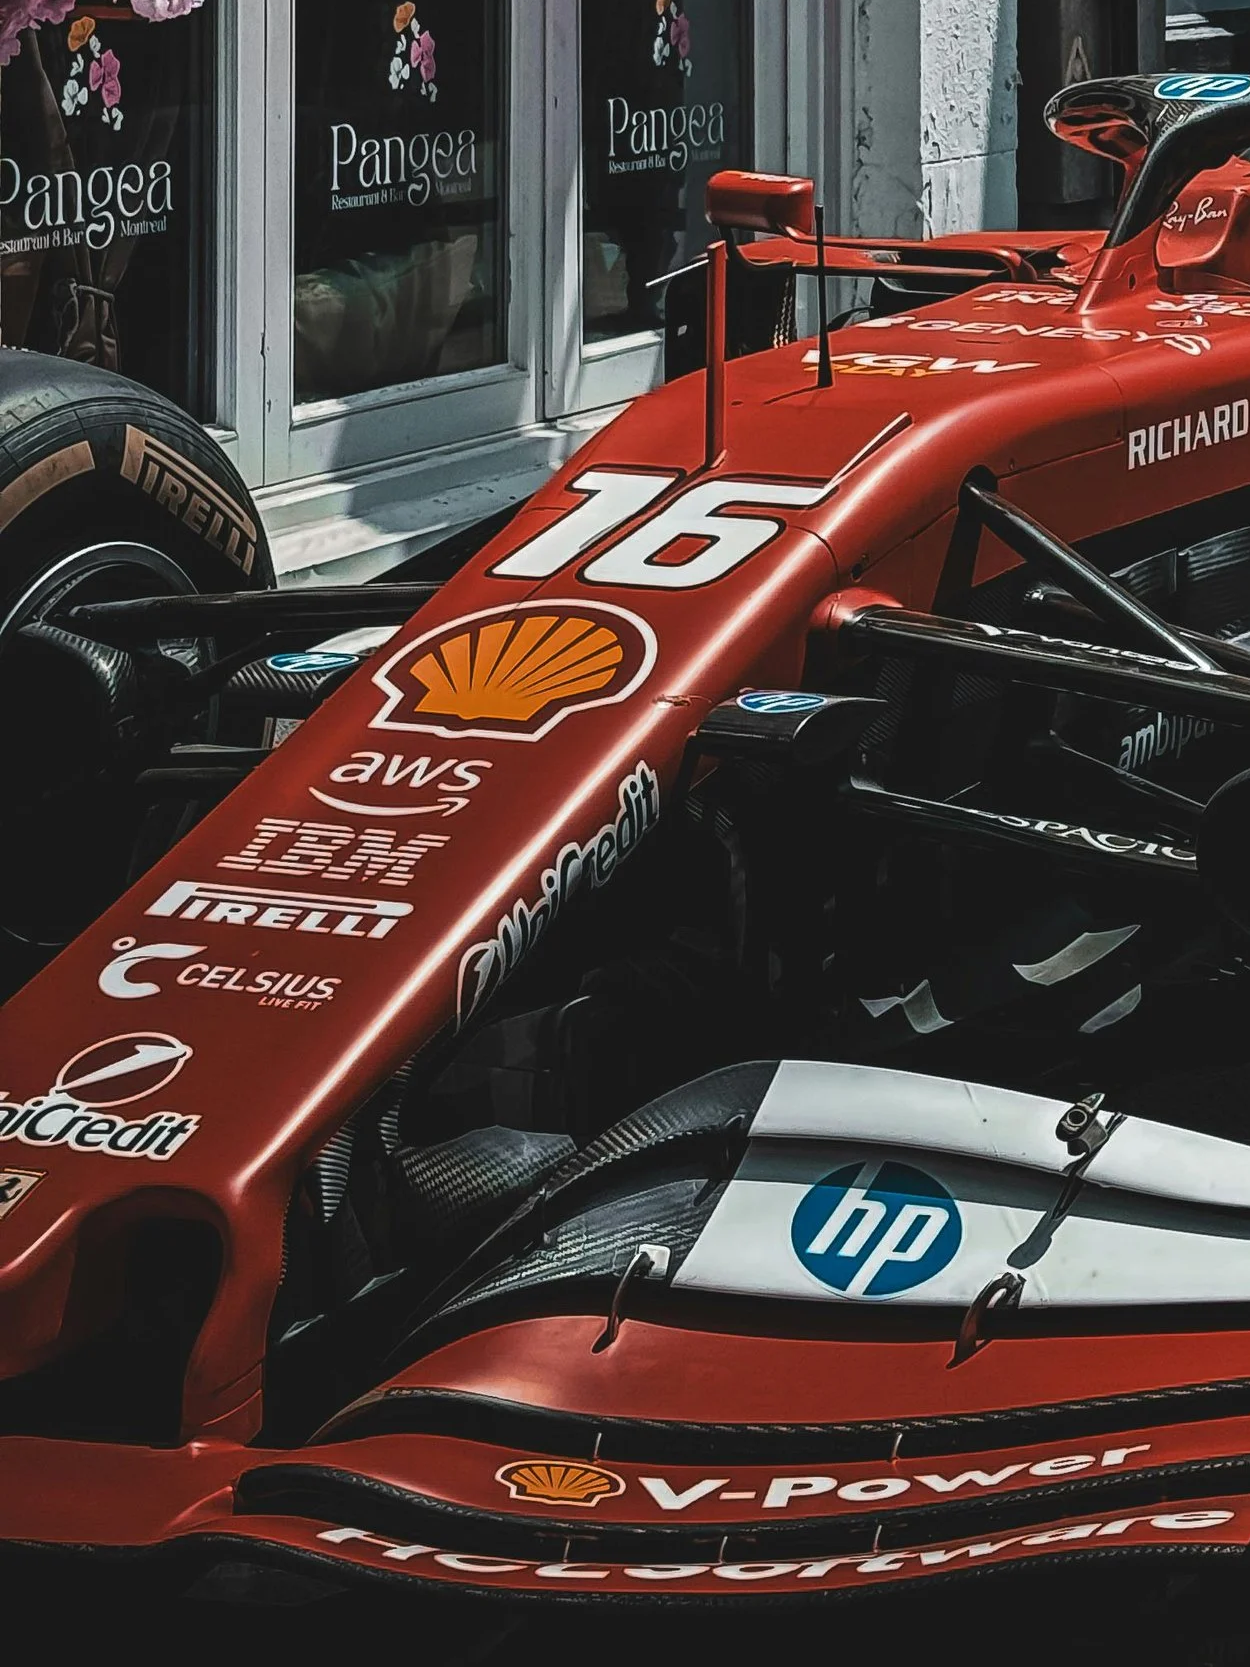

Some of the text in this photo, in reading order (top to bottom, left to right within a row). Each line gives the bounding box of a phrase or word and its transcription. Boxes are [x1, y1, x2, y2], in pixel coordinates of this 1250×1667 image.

[330, 123, 478, 207] Pangea
[608, 97, 725, 172] Pangea
[63, 227, 85, 246] Bar
[120, 215, 167, 238] Montreal
[331, 191, 380, 210] Restaurant
[1163, 196, 1229, 233] Ray-Ban
[907, 319, 1211, 356] GENESYS
[1128, 398, 1250, 470] RICHARD
[120, 423, 258, 576] PIRELLI
[488, 468, 832, 589] 16
[329, 750, 493, 792] aws
[216, 817, 452, 886] IBM
[144, 880, 414, 939] PIRELLI
[176, 962, 343, 1000] CELSIUS
[257, 996, 323, 1012] LIVE FIT
[802, 1160, 951, 1297] hp
[636, 1441, 1152, 1511] V-Power
[315, 1502, 1237, 1580] HCLSoftware
